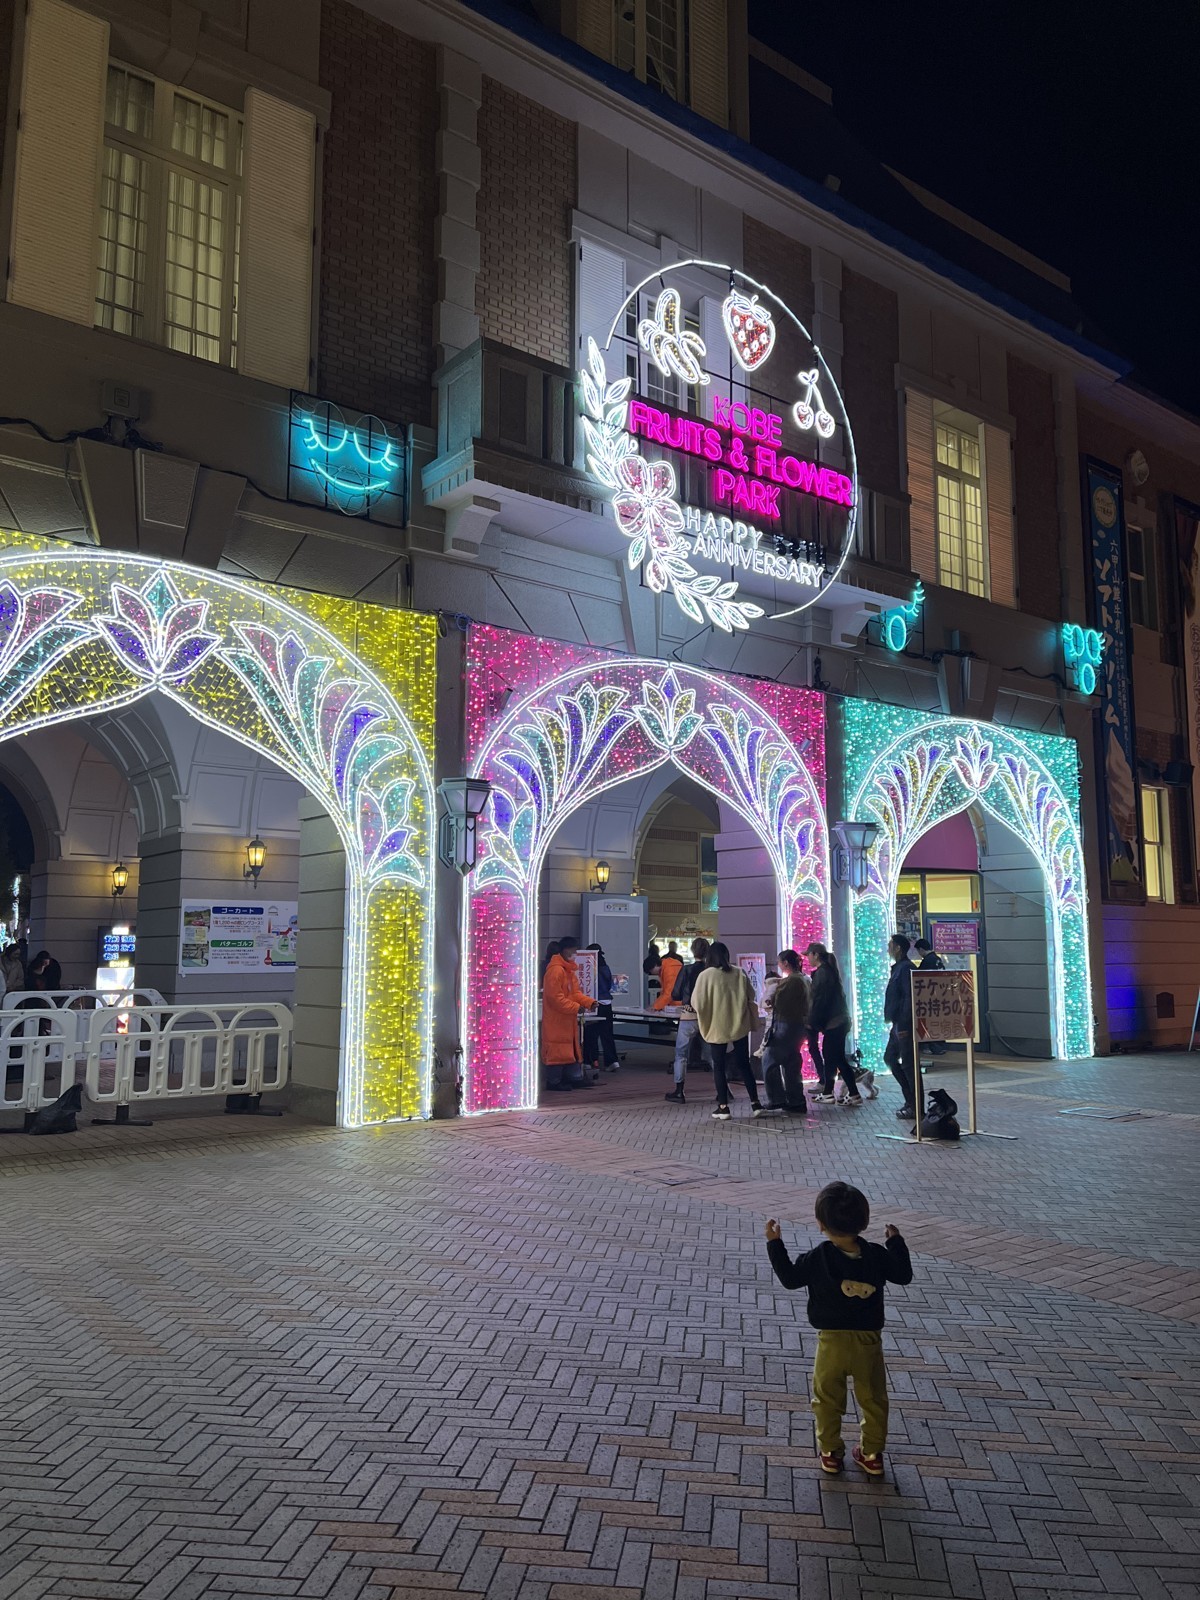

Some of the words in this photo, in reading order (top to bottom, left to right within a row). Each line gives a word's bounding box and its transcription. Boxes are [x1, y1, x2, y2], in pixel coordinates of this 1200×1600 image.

[712, 395, 783, 448] KOBE
[629, 400, 723, 462] FRUITS
[729, 437, 749, 472] &
[755, 445, 853, 507] FLOWER
[715, 468, 781, 518] PARK
[685, 506, 763, 549] HAPPY
[692, 534, 824, 588] ANNIVERSARY
[1095, 558, 1120, 727] ソフトクリーム
[914, 979, 971, 997] チケットの
[915, 997, 974, 1018] お持ちの方
[930, 1019, 962, 1039] こちら
